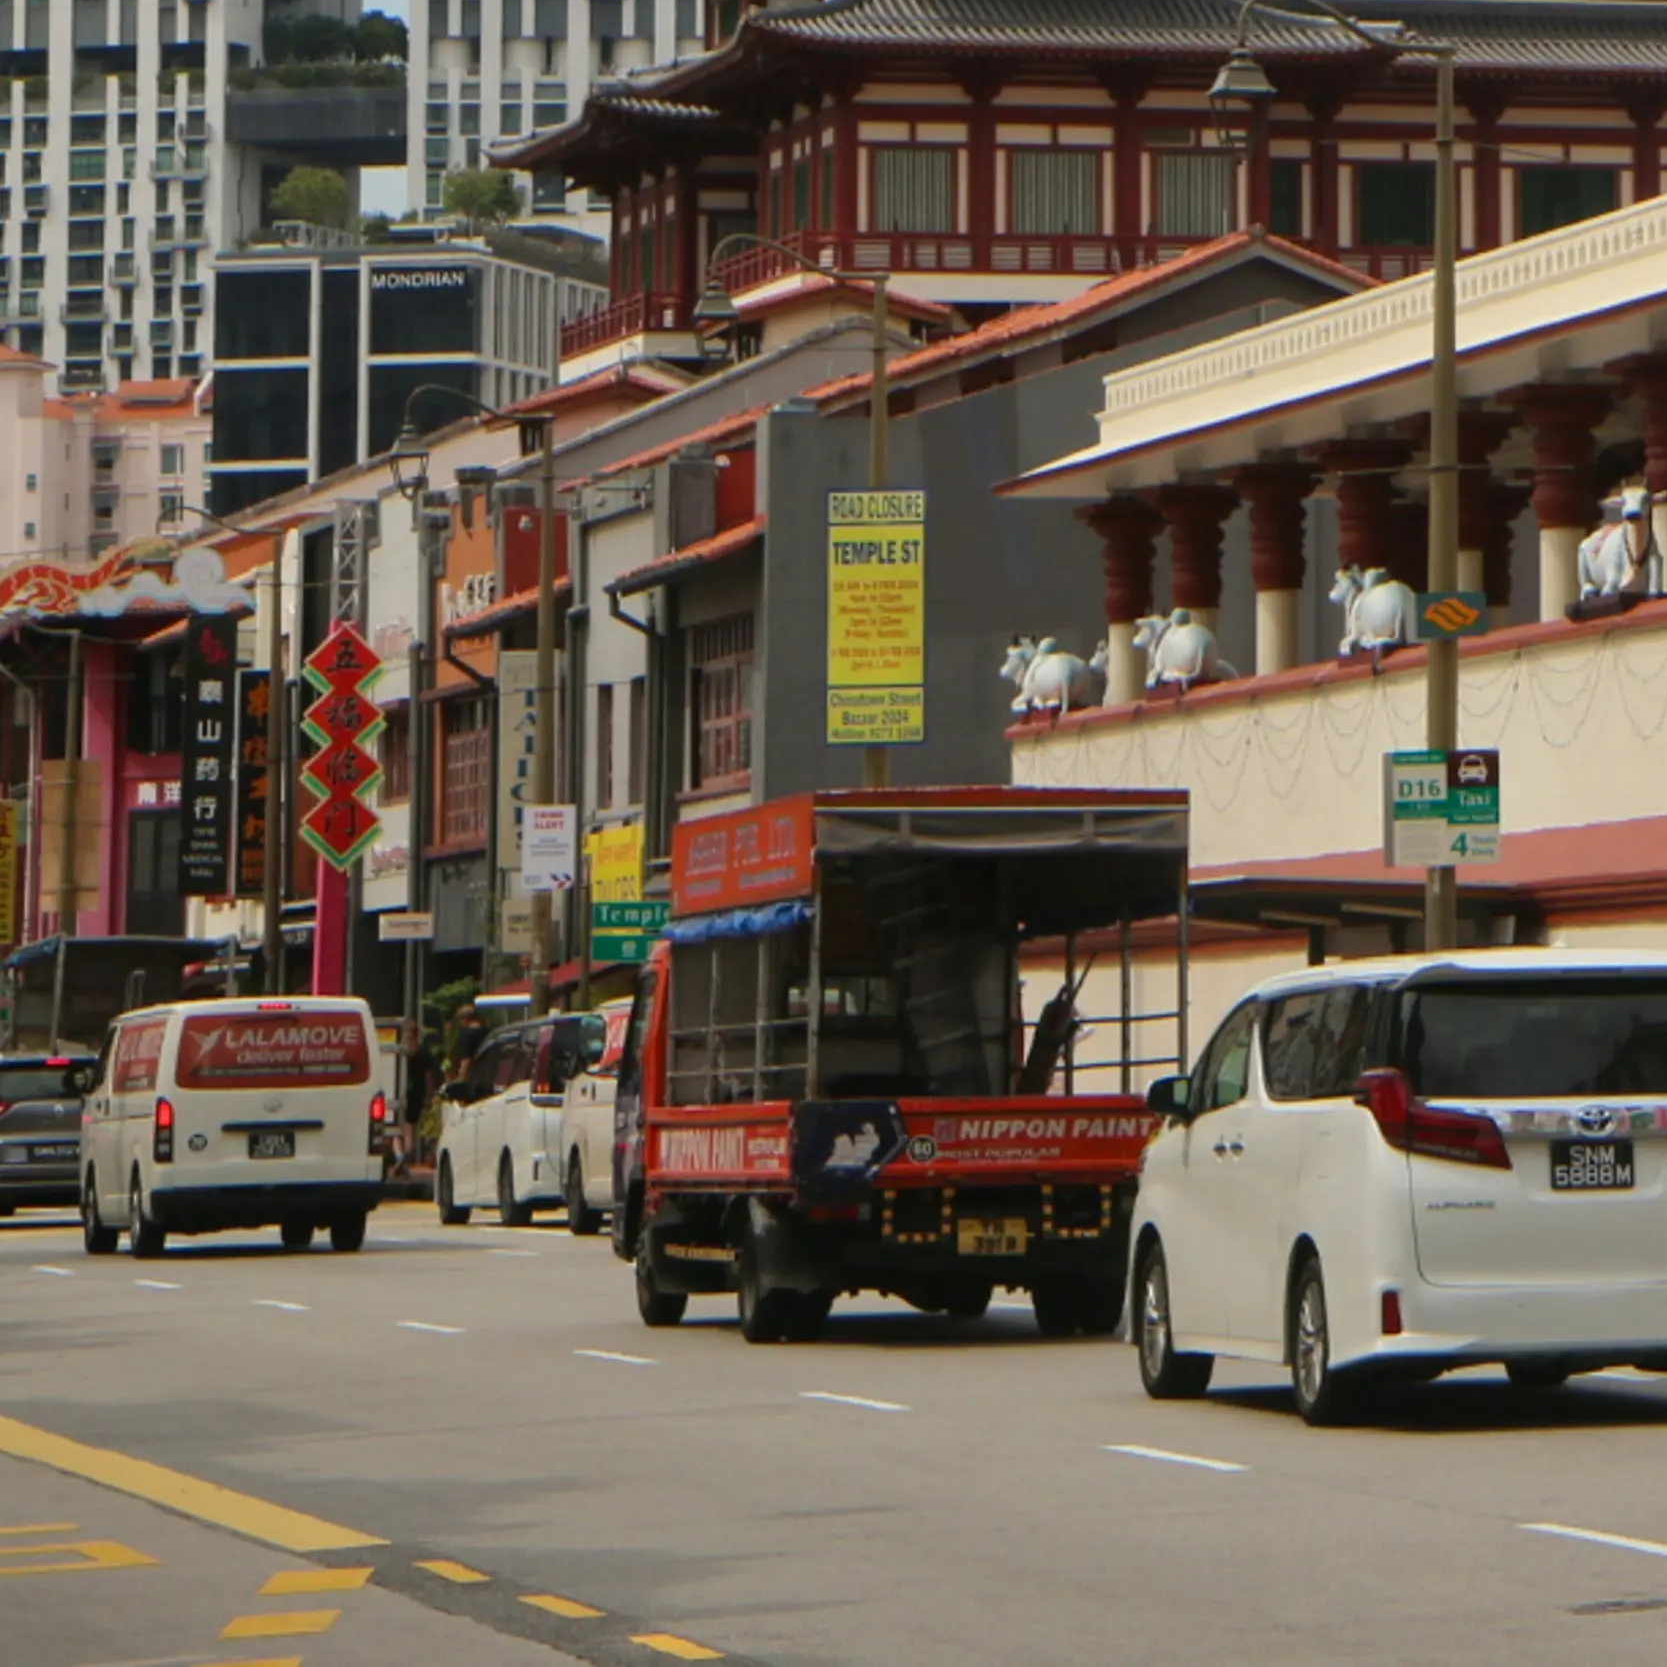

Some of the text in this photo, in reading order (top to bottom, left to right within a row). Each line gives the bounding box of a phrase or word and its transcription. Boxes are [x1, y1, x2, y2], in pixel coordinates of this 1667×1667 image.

[371, 271, 466, 288] MONDRIAN
[832, 493, 922, 520] ROAD CLOSURE
[832, 539, 921, 565] TEMPLE ST
[324, 639, 365, 838] 五福临门
[1398, 779, 1441, 797] D16
[1456, 790, 1491, 807] Taxi
[1449, 831, 1468, 858] 4
[224, 1025, 361, 1047] LALAMOVE
[236, 1048, 295, 1064] deliver
[959, 1117, 1153, 1140] NIPPON PAINT
[1569, 1144, 1615, 1165] SNM
[1555, 1165, 1633, 1187] 5888M
